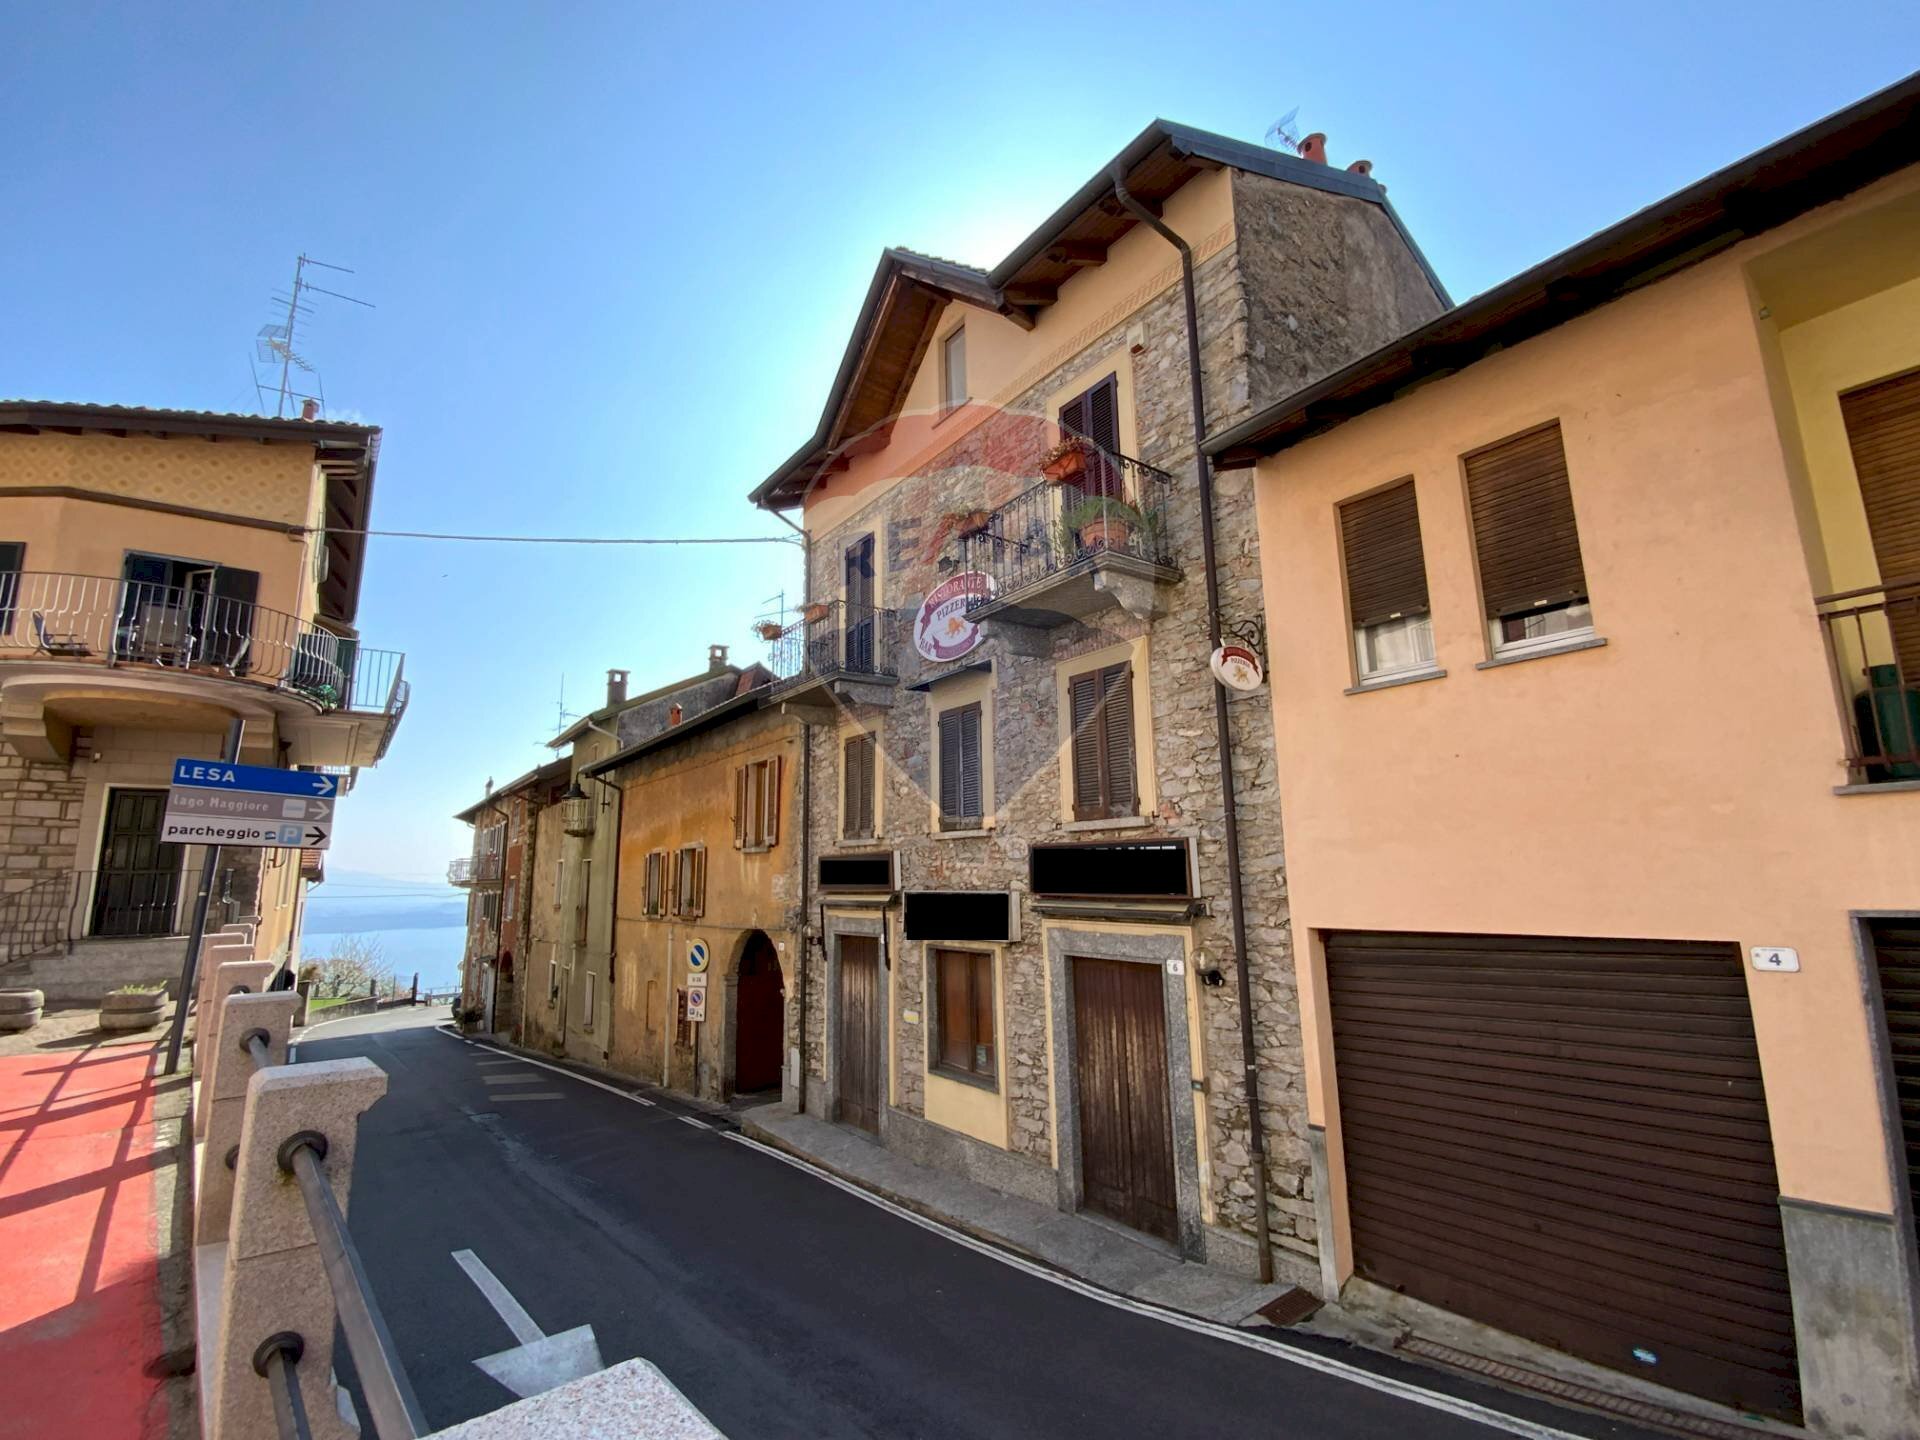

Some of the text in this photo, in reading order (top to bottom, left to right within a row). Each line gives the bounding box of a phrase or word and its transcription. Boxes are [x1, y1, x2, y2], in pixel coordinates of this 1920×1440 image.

[179, 765, 236, 783] LESA
[209, 797, 270, 812] Maggiore
[168, 826, 260, 840] parcheggio
[1768, 952, 1782, 966] 4
